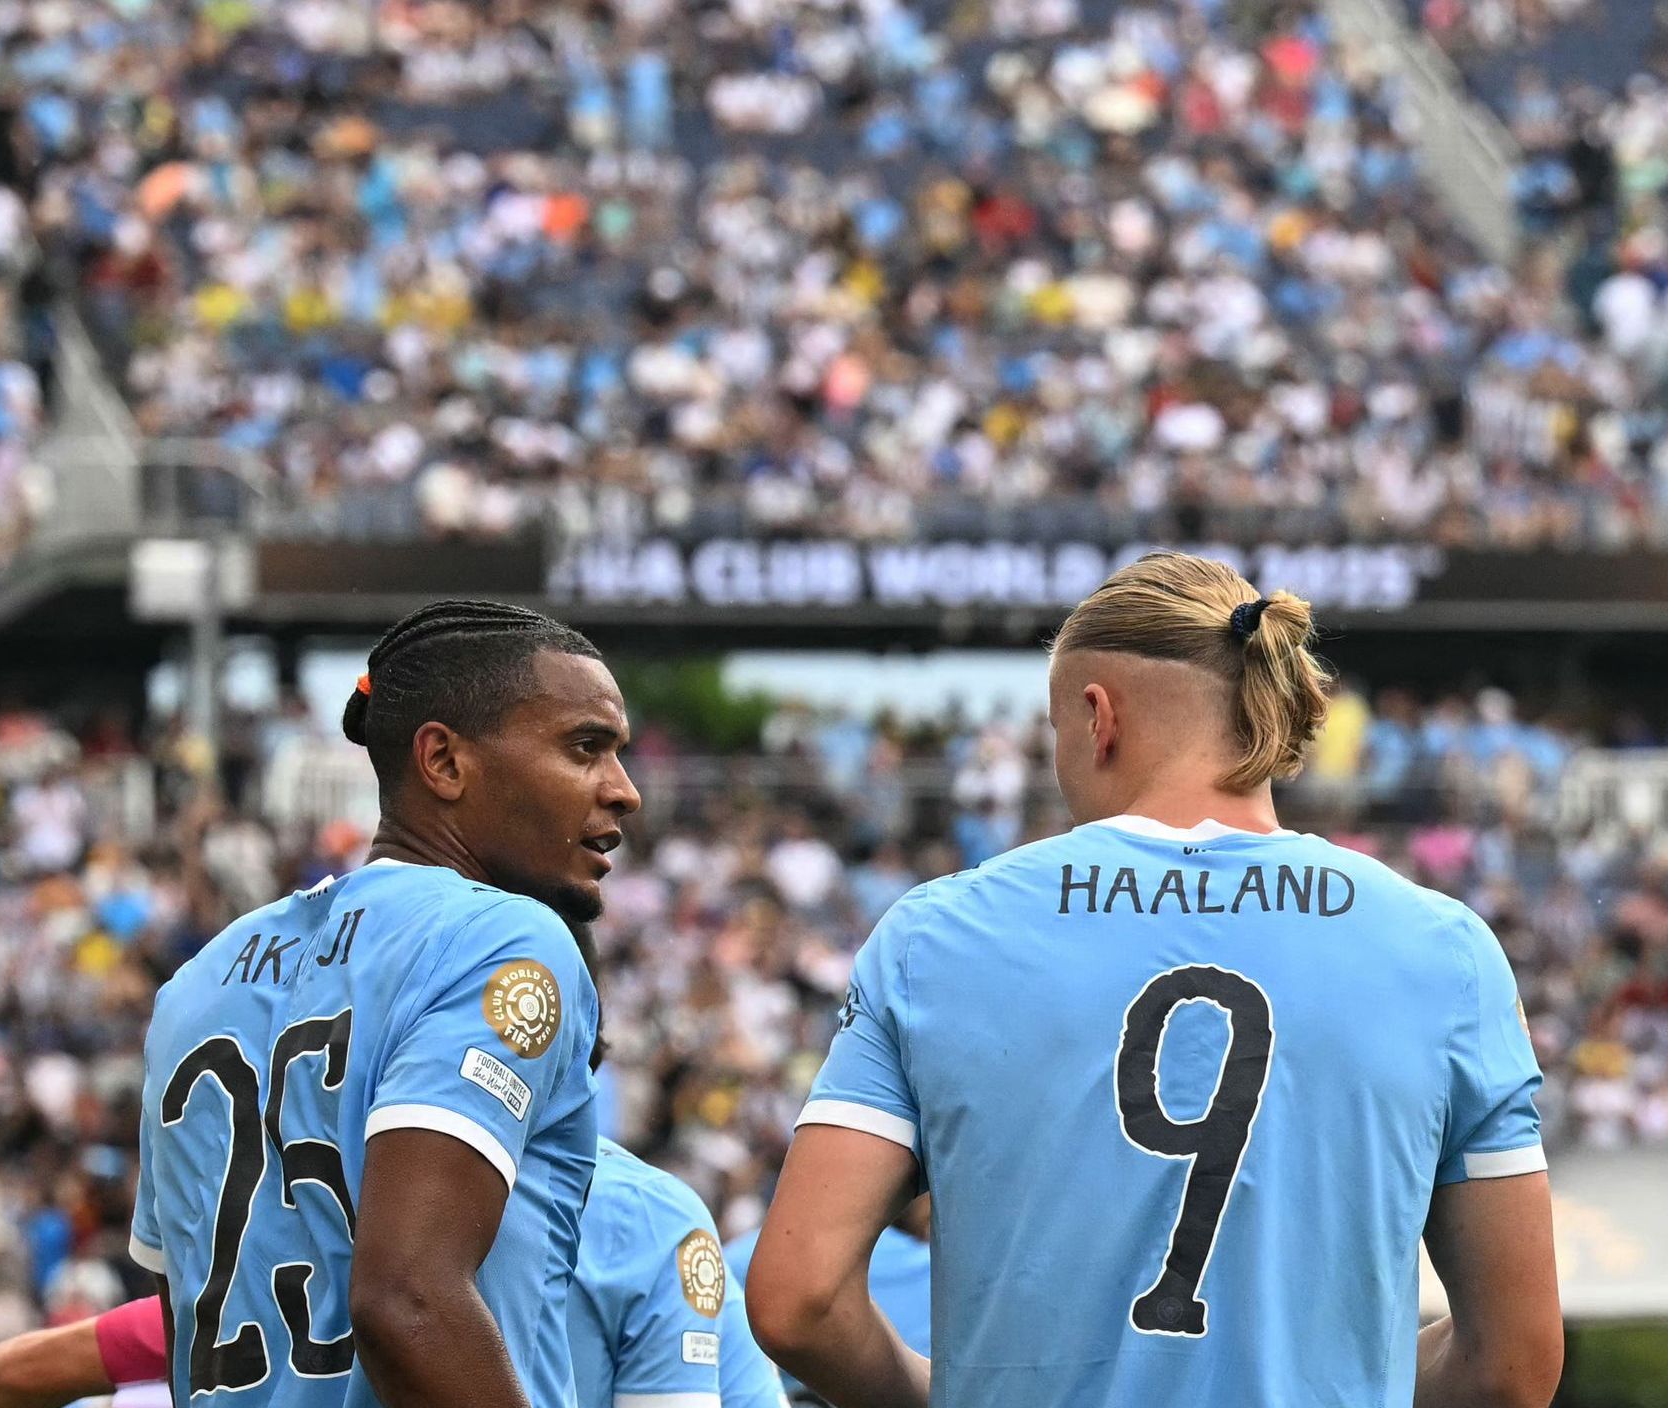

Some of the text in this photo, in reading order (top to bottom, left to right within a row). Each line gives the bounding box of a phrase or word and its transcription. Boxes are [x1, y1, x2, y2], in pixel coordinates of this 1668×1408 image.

[691, 540, 862, 605] CLUB
[869, 540, 1106, 606] WORLD
[1058, 864, 1355, 916] HAALAND
[221, 907, 366, 986] AKJI
[499, 969, 541, 987] WORLD
[542, 979, 556, 1003] CUP
[492, 989, 504, 1020] CLUB
[504, 1023, 532, 1051] FIFA
[535, 1025, 551, 1045] USA
[472, 1066, 510, 1098] the World
[476, 1054, 527, 1100] FOOTBALL UNITES
[1114, 963, 1275, 1337] 9
[160, 1007, 354, 1400] 25
